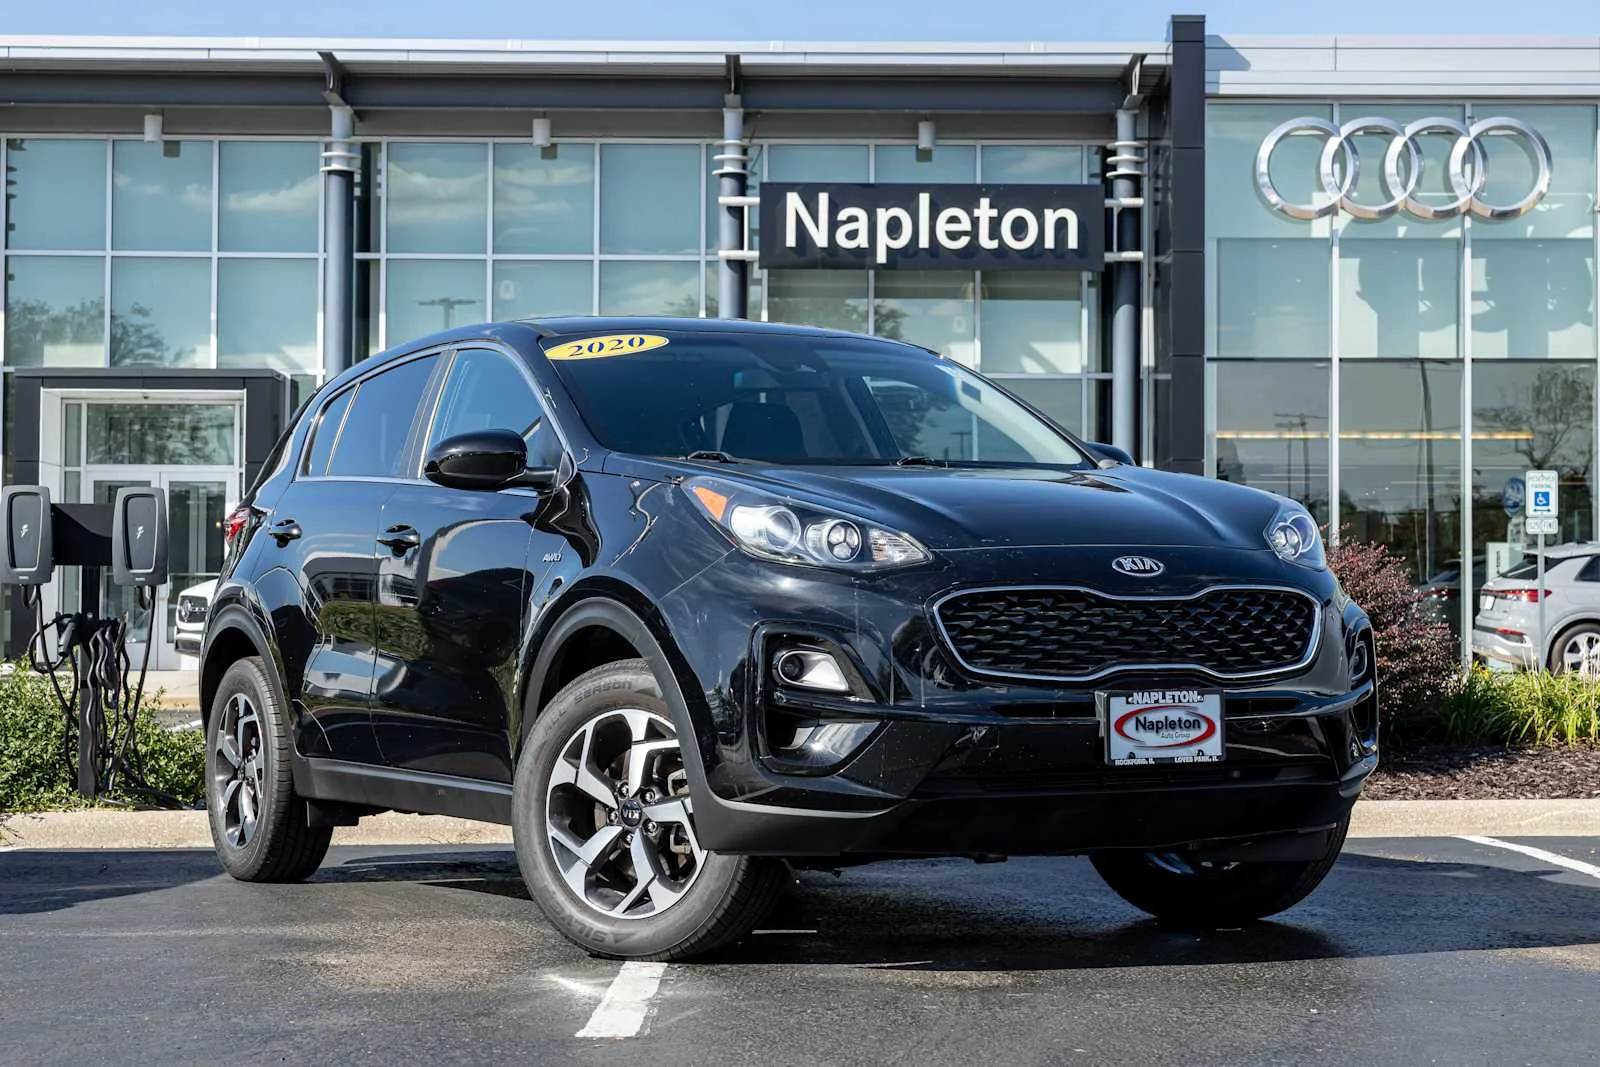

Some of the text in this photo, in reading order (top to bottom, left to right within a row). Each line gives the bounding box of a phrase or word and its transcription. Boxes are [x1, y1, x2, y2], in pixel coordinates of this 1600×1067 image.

[785, 191, 1079, 264] Napleton
[568, 336, 645, 357] 2020
[543, 552, 562, 562] AWD
[1120, 557, 1159, 571] KIA
[1133, 690, 1199, 704] NAPLETON
[1135, 716, 1202, 734] Napleton
[1161, 731, 1191, 739] Auto Group
